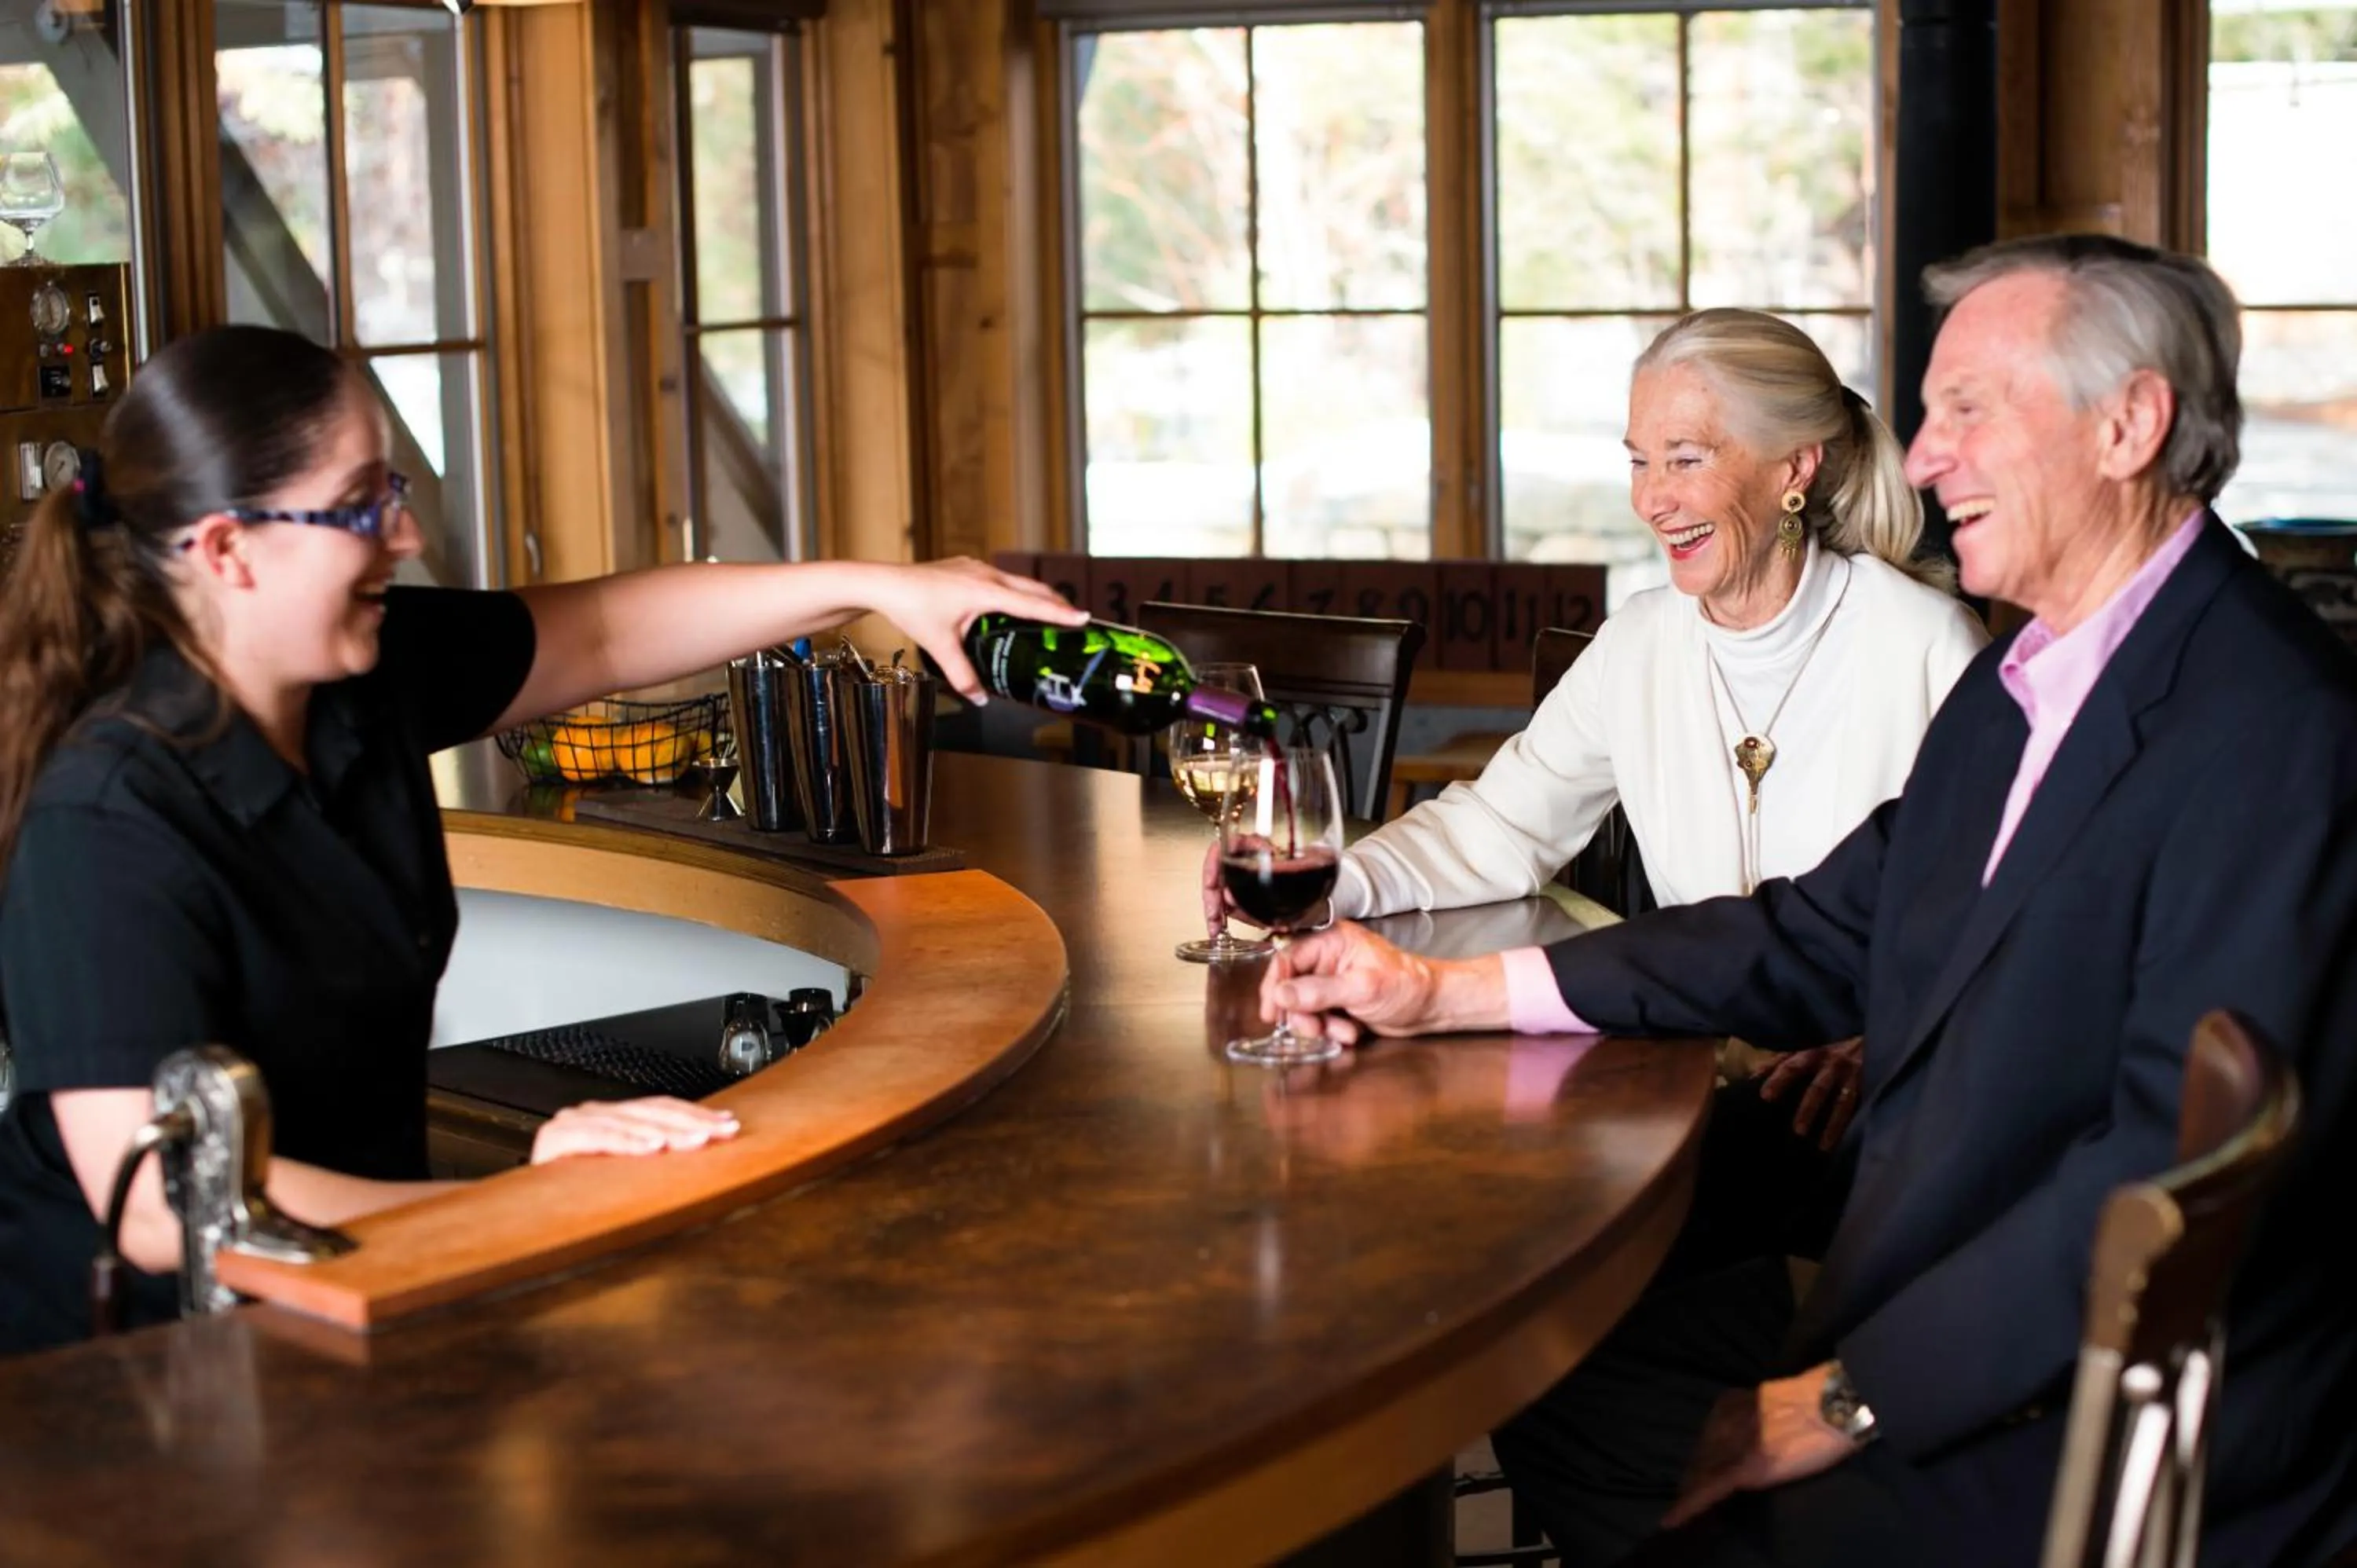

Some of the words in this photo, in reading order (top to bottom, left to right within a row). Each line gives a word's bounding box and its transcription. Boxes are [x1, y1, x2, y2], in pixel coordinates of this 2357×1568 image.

[1445, 588, 1490, 643] 10
[1505, 589, 1537, 647] 11
[1553, 592, 1593, 630] 12
